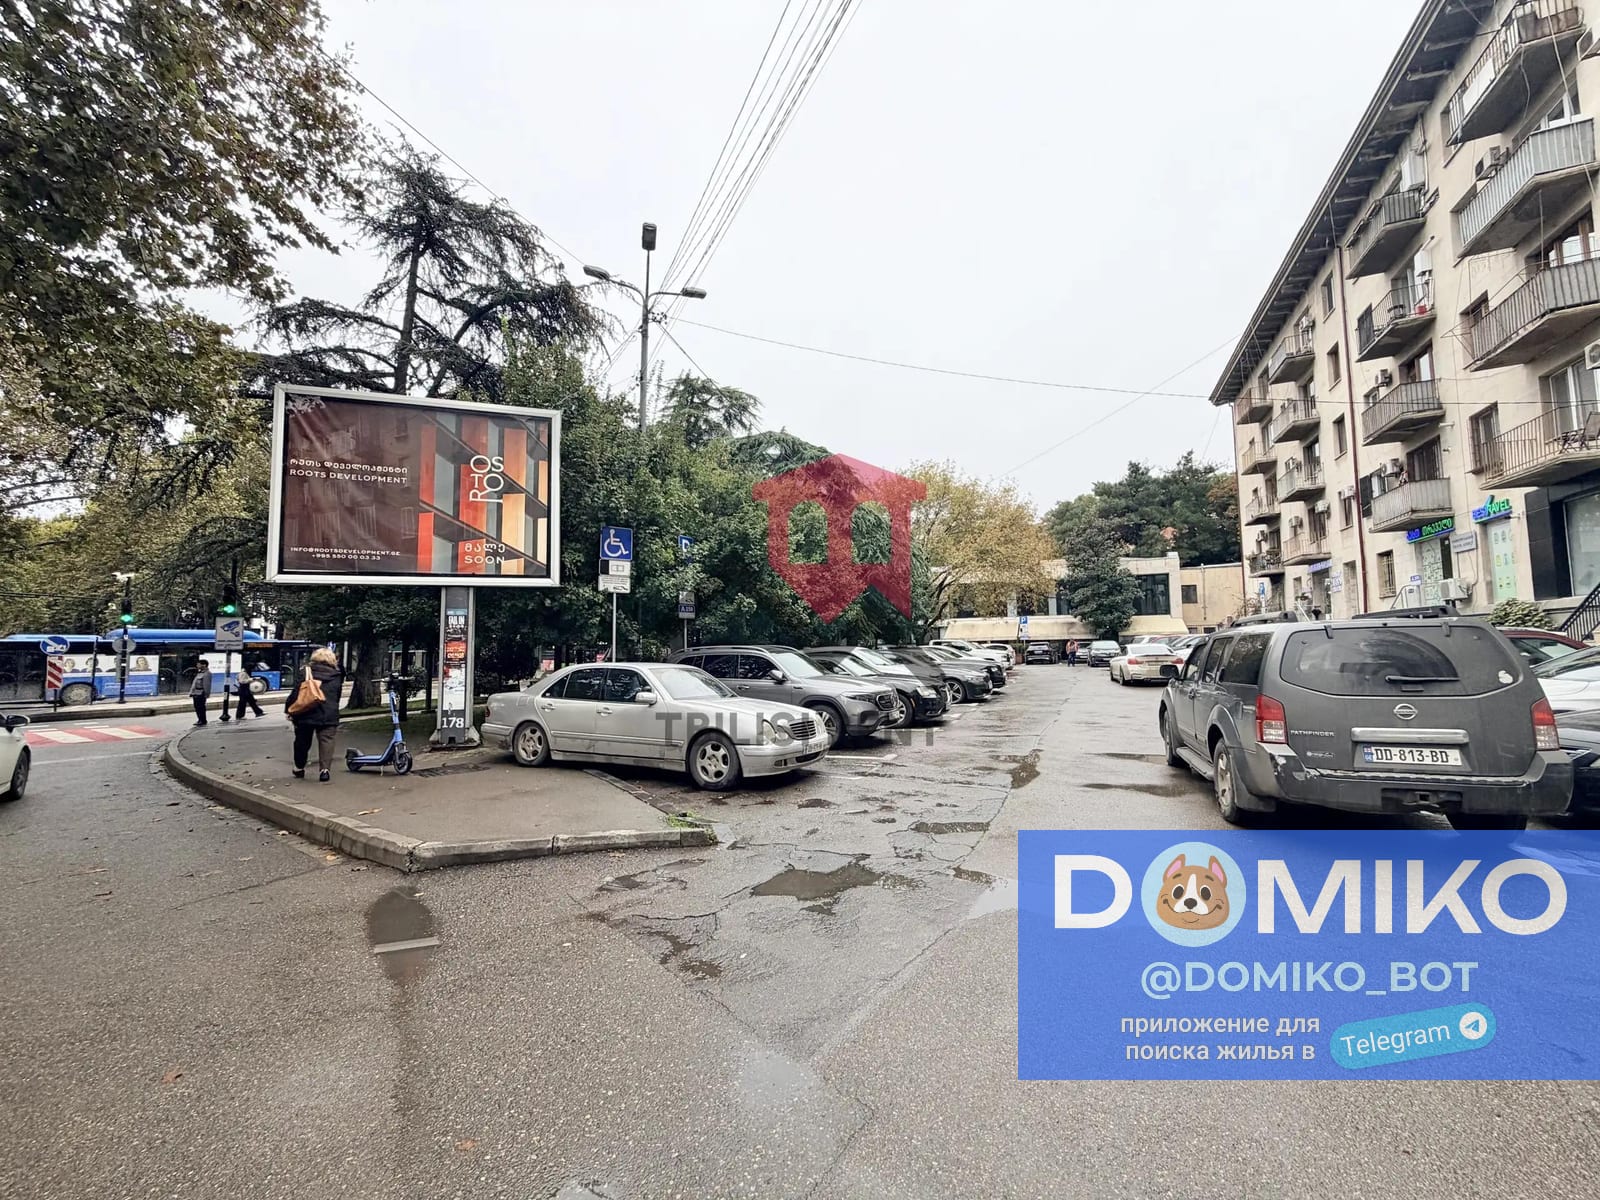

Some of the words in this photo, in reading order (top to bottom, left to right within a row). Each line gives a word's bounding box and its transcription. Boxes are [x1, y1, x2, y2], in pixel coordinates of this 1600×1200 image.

[289, 469, 327, 479] ROOTS
[329, 472, 408, 484] DEVELOPMENT
[464, 542, 506, 553] მალე
[464, 555, 505, 565] SOON
[442, 717, 464, 728] 178
[1374, 748, 1449, 763] DD-813-BD
